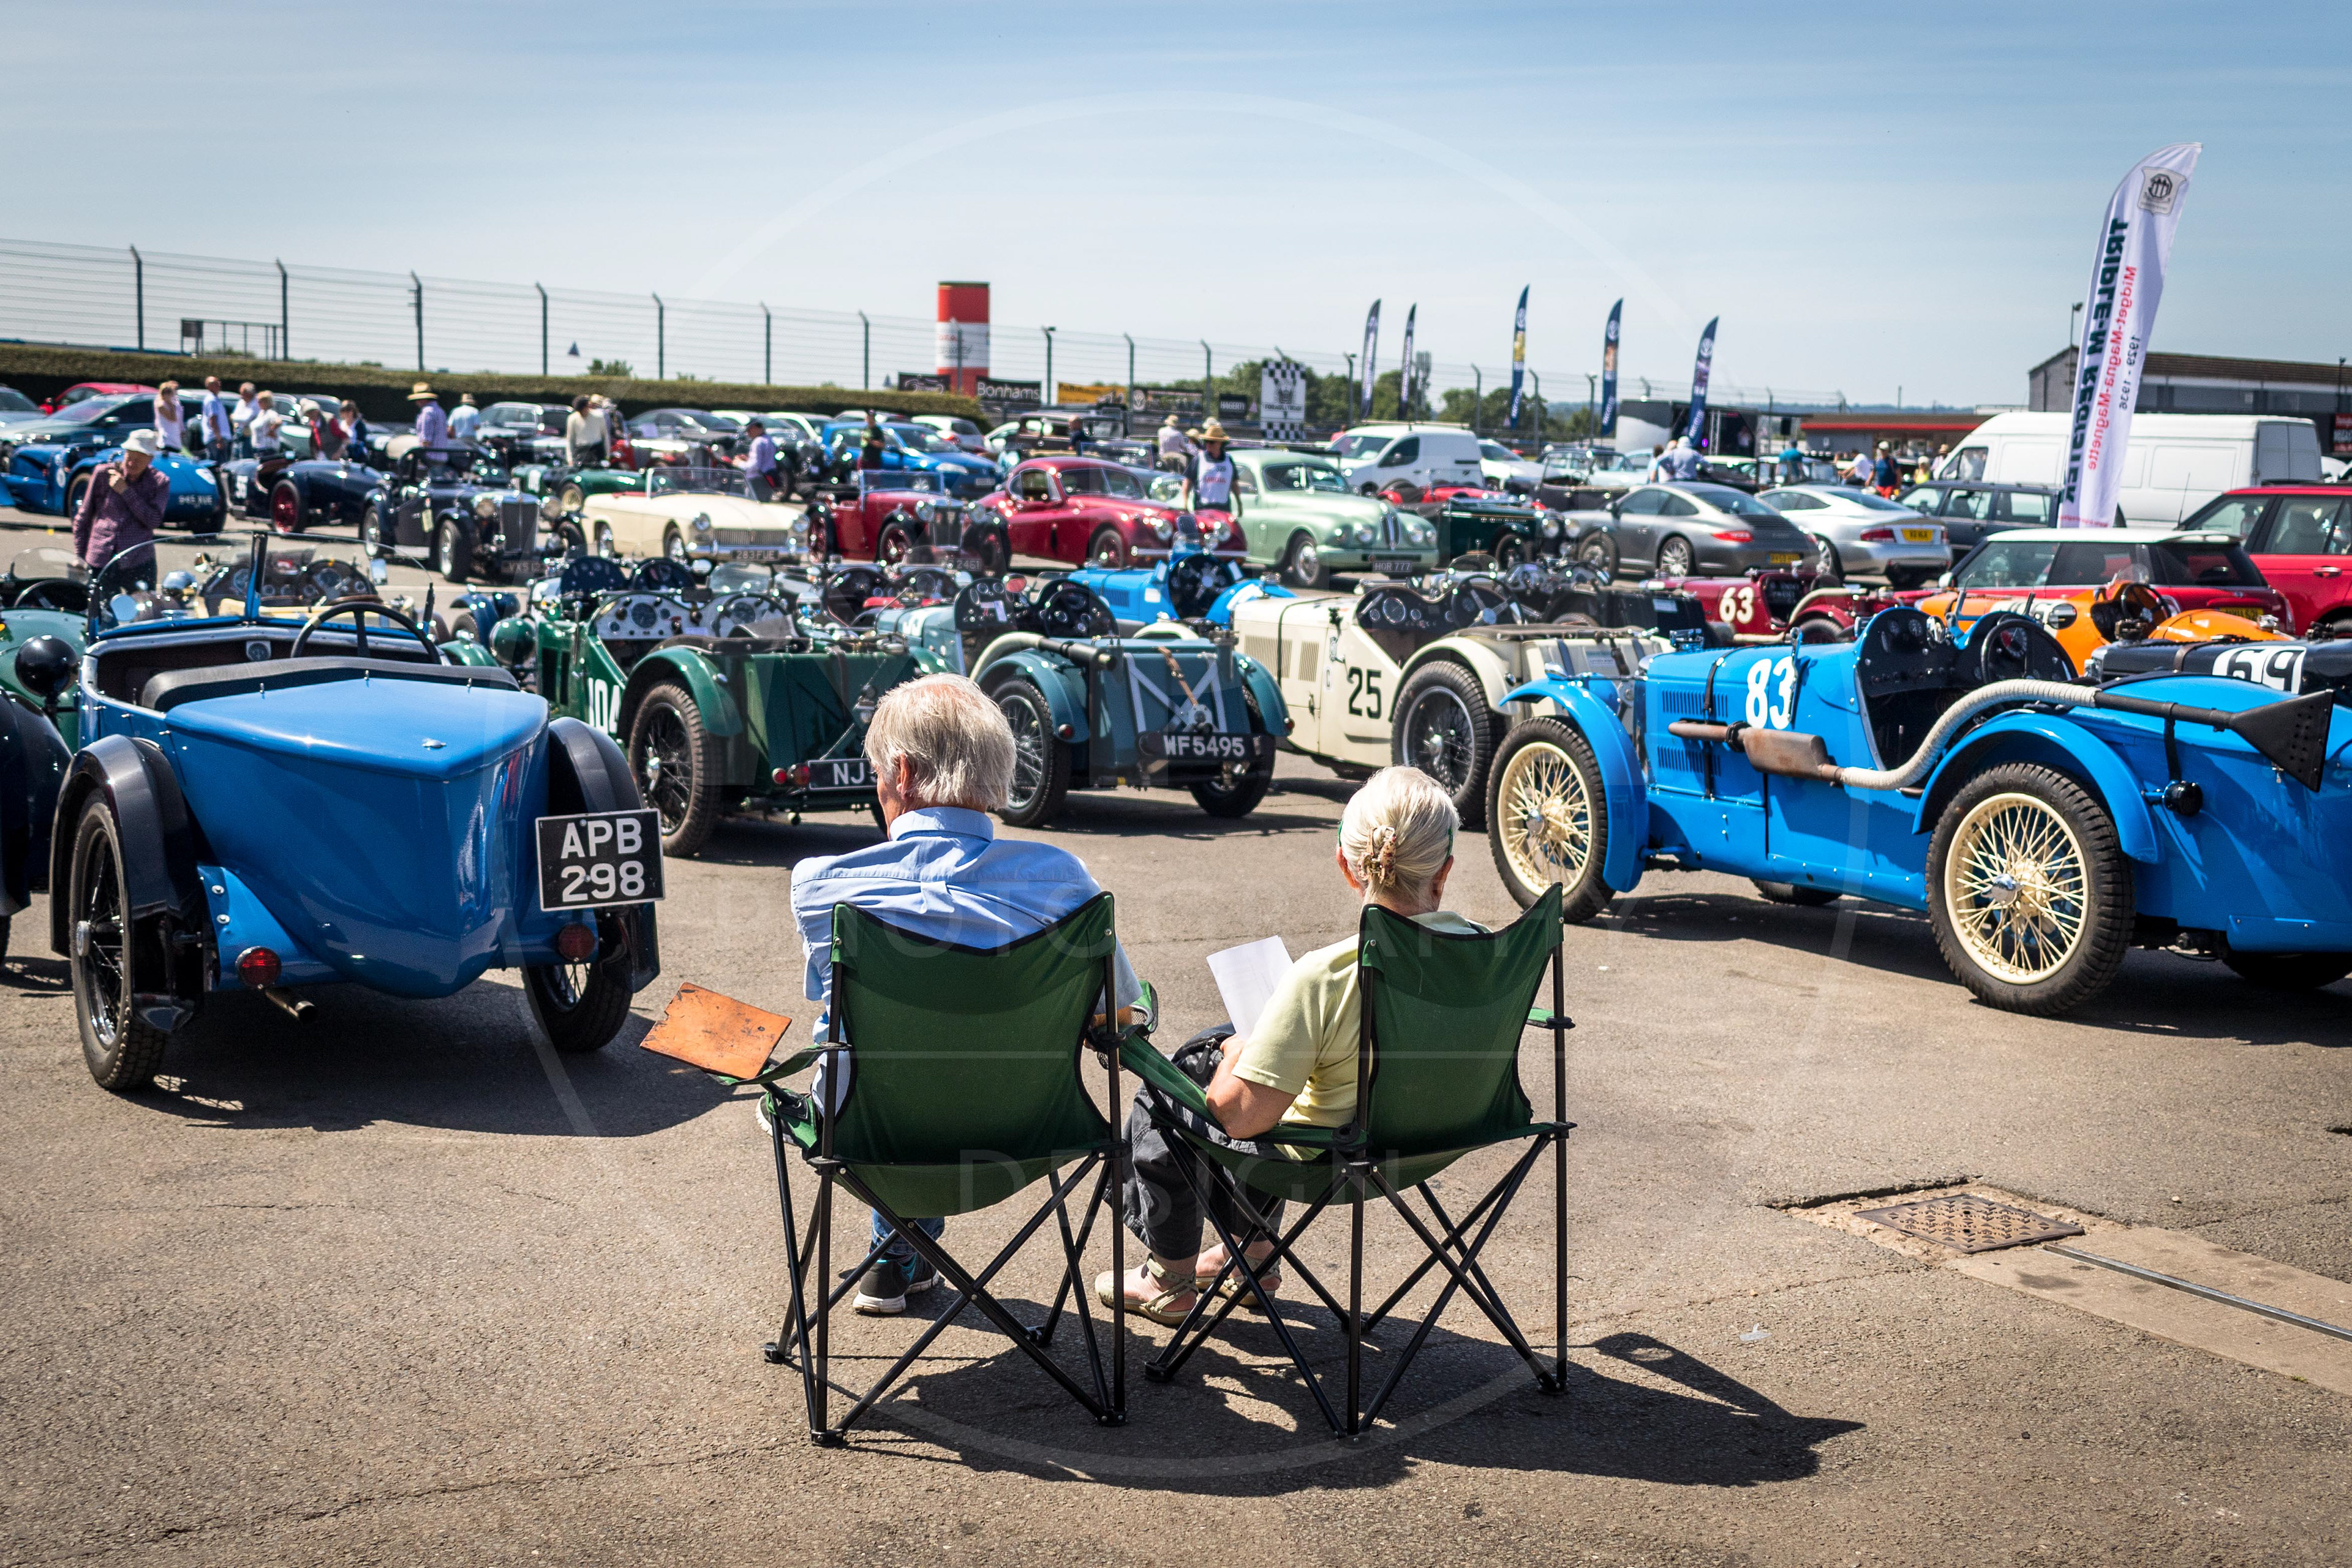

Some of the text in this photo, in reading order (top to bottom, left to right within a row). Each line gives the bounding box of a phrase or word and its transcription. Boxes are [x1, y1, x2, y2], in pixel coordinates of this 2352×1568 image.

[977, 382, 1040, 399] Bonhams
[1220, 401, 1246, 411] HAGERTY
[1374, 562, 1411, 571] HOR 777
[1719, 587, 1754, 624] 63
[1348, 666, 1382, 720] 25
[1745, 656, 1797, 730] 83
[560, 818, 643, 859] APB
[561, 861, 645, 902] 298
